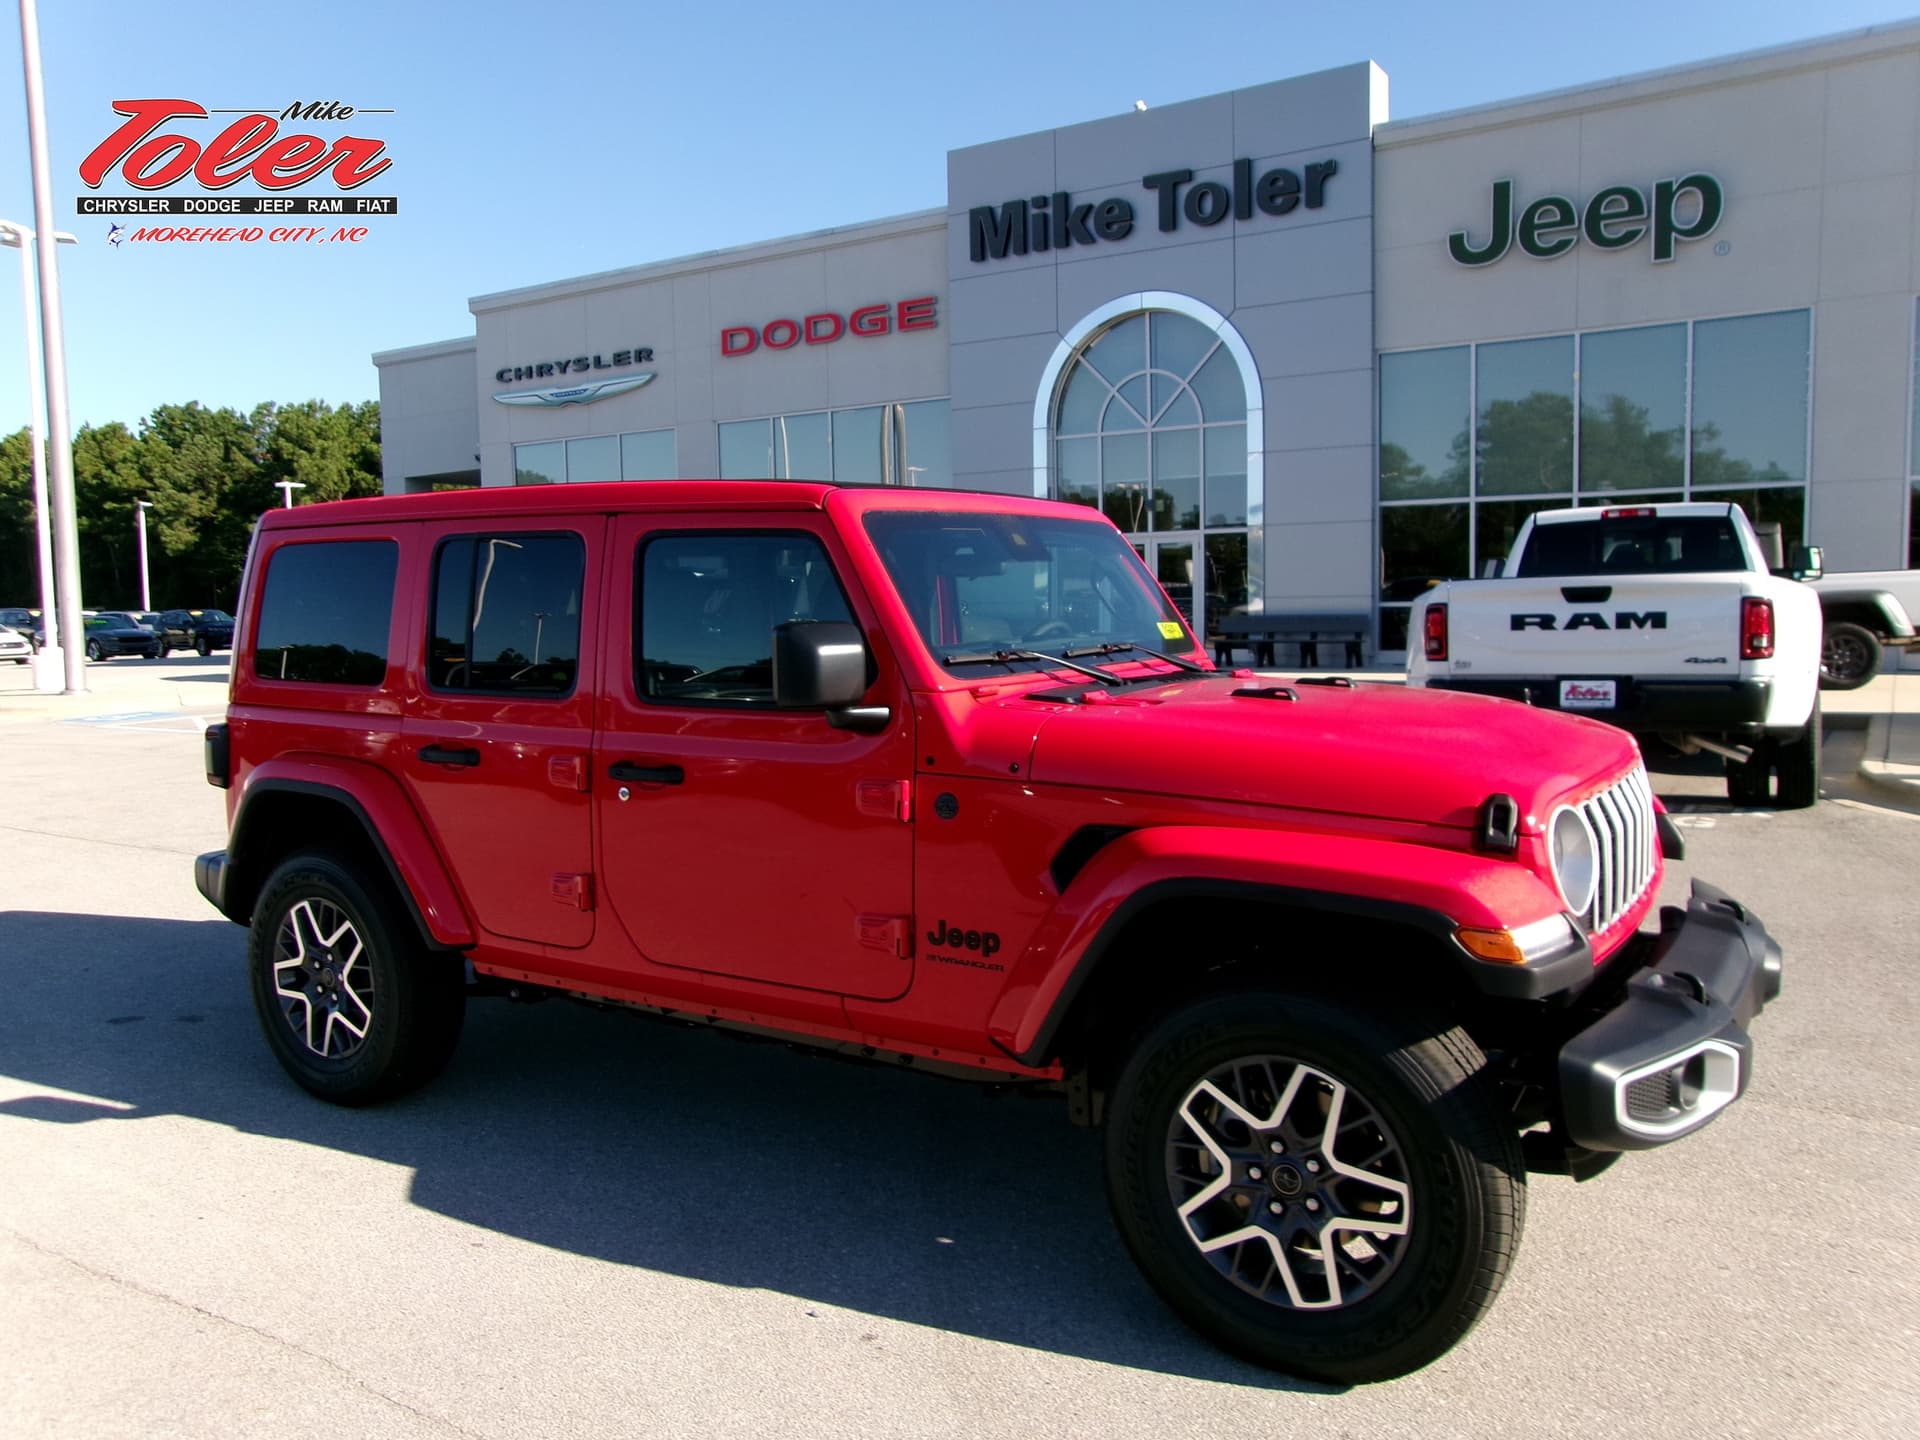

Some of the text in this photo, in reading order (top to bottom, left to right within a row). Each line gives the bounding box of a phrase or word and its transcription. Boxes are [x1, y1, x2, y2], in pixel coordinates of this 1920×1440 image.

[969, 158, 1338, 263] Mike Toler
[1448, 171, 1724, 268] Jeep
[720, 296, 938, 358] DODGE
[495, 347, 655, 384] CHRYSLER
[1510, 611, 1667, 631] RAM
[927, 919, 1001, 957] Jeep
